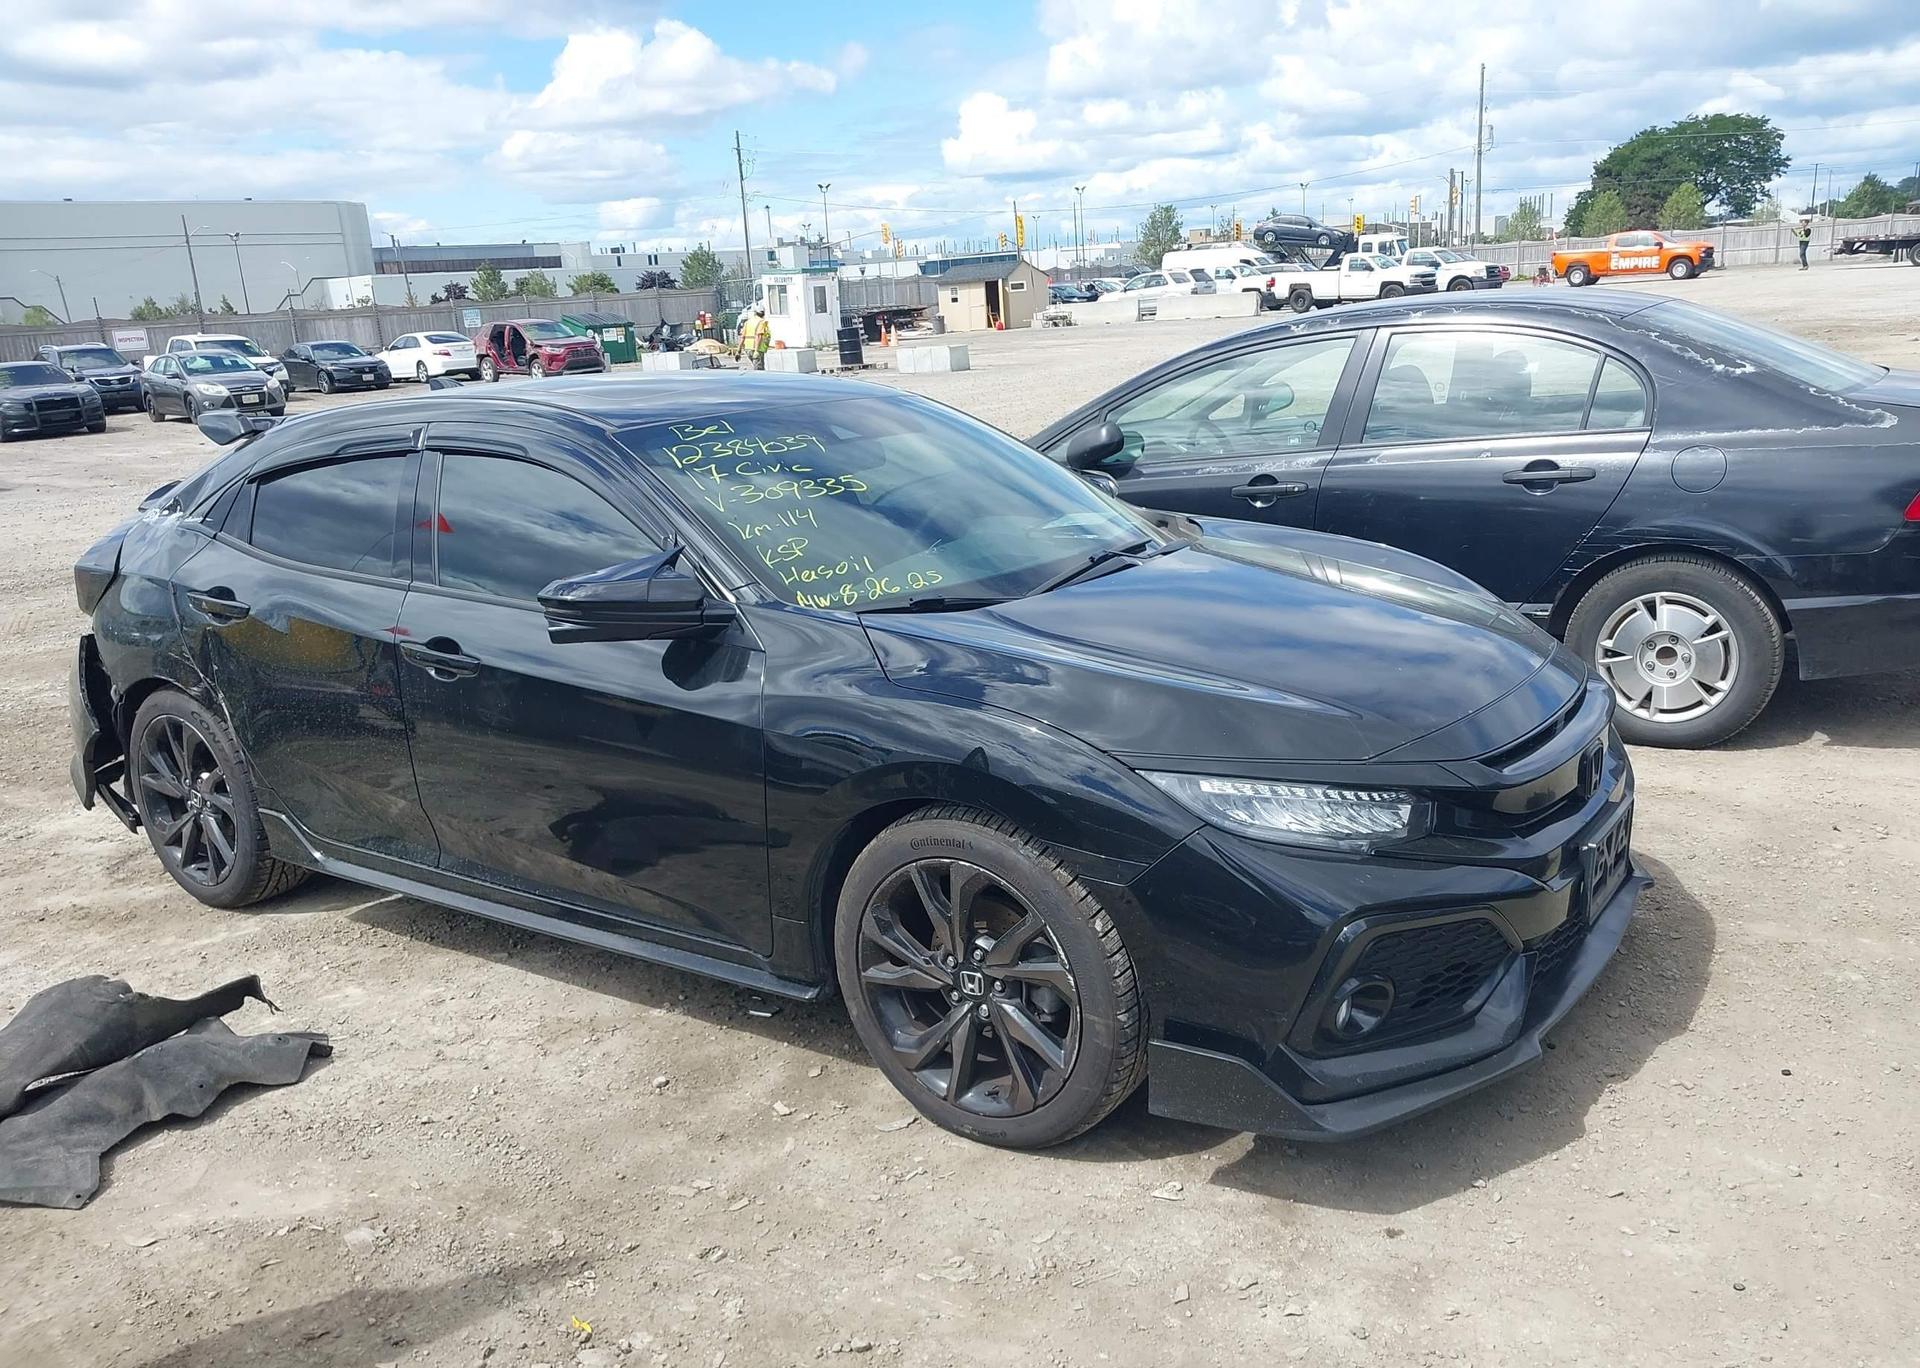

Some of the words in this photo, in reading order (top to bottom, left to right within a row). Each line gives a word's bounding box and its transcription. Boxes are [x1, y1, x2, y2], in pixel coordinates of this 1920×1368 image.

[1610, 256, 1660, 270] EMPIRE
[684, 463, 730, 491] 17
[735, 460, 815, 476] Civic
[755, 536, 809, 570] KSP
[910, 835, 966, 851] Continental
